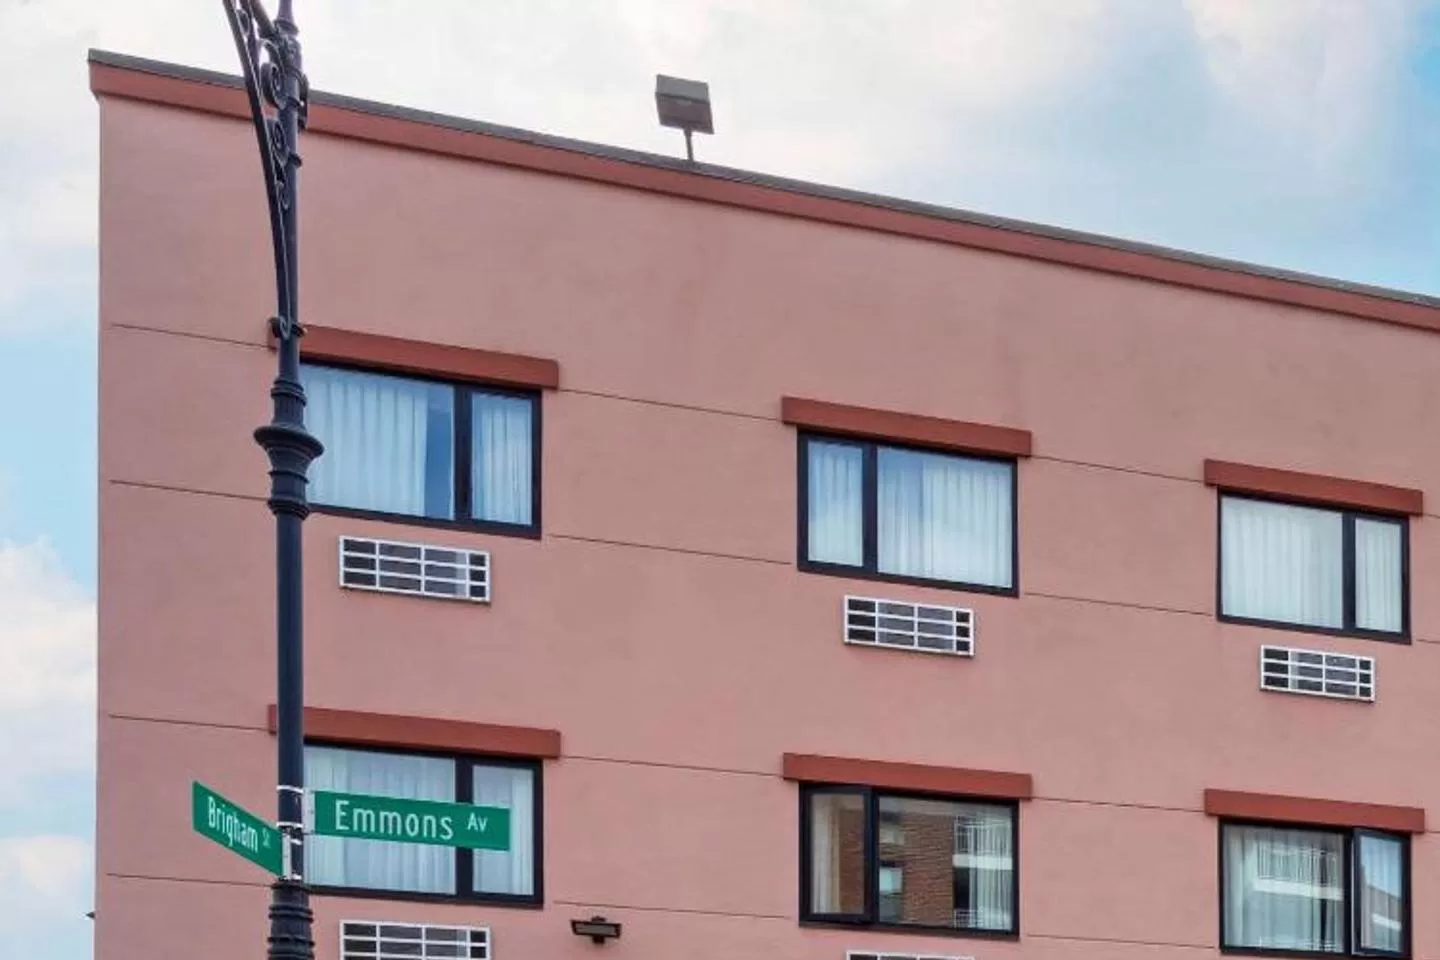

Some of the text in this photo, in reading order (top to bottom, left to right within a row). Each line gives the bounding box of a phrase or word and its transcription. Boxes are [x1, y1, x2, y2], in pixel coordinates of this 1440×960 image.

[207, 796, 258, 852] Brigham
[335, 801, 488, 840] Emmons Av
